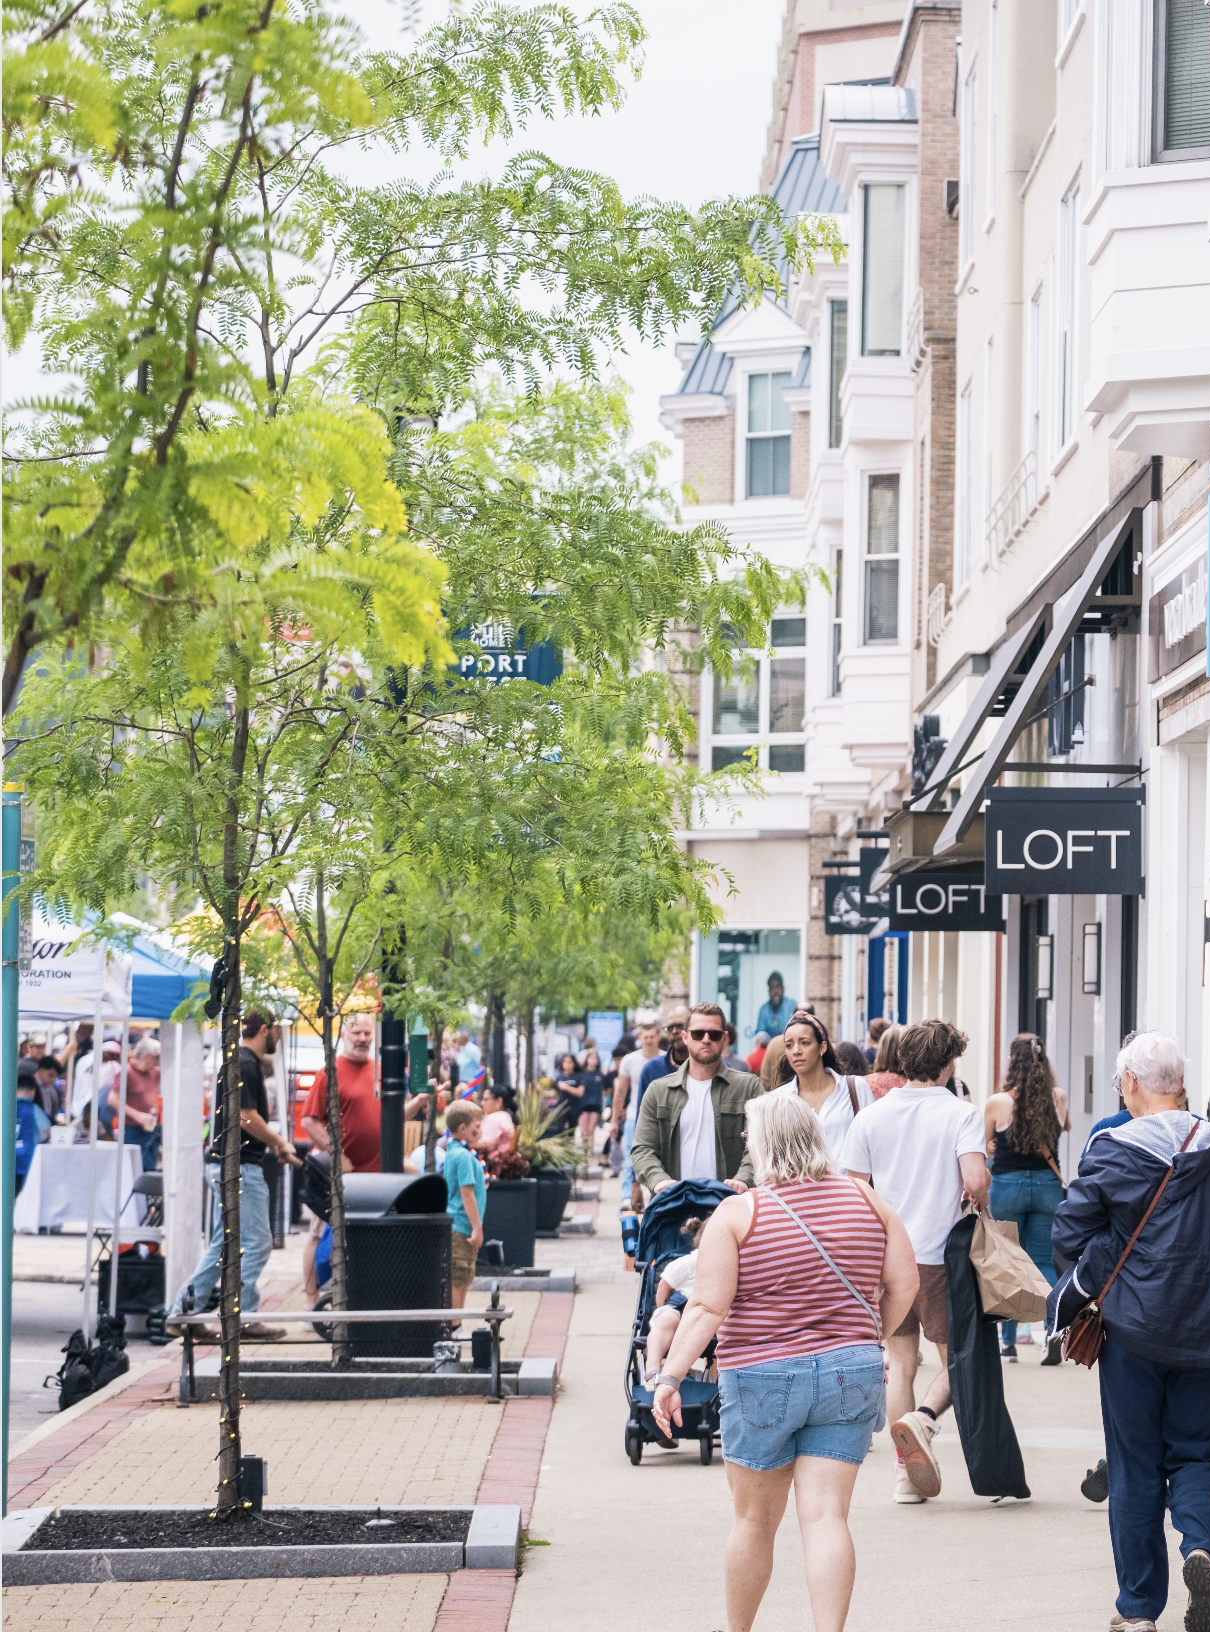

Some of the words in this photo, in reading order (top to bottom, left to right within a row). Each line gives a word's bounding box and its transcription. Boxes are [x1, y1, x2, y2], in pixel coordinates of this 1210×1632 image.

[460, 654, 528, 673] PORT
[996, 829, 1131, 870] LOFT
[896, 883, 986, 915] LOFT
